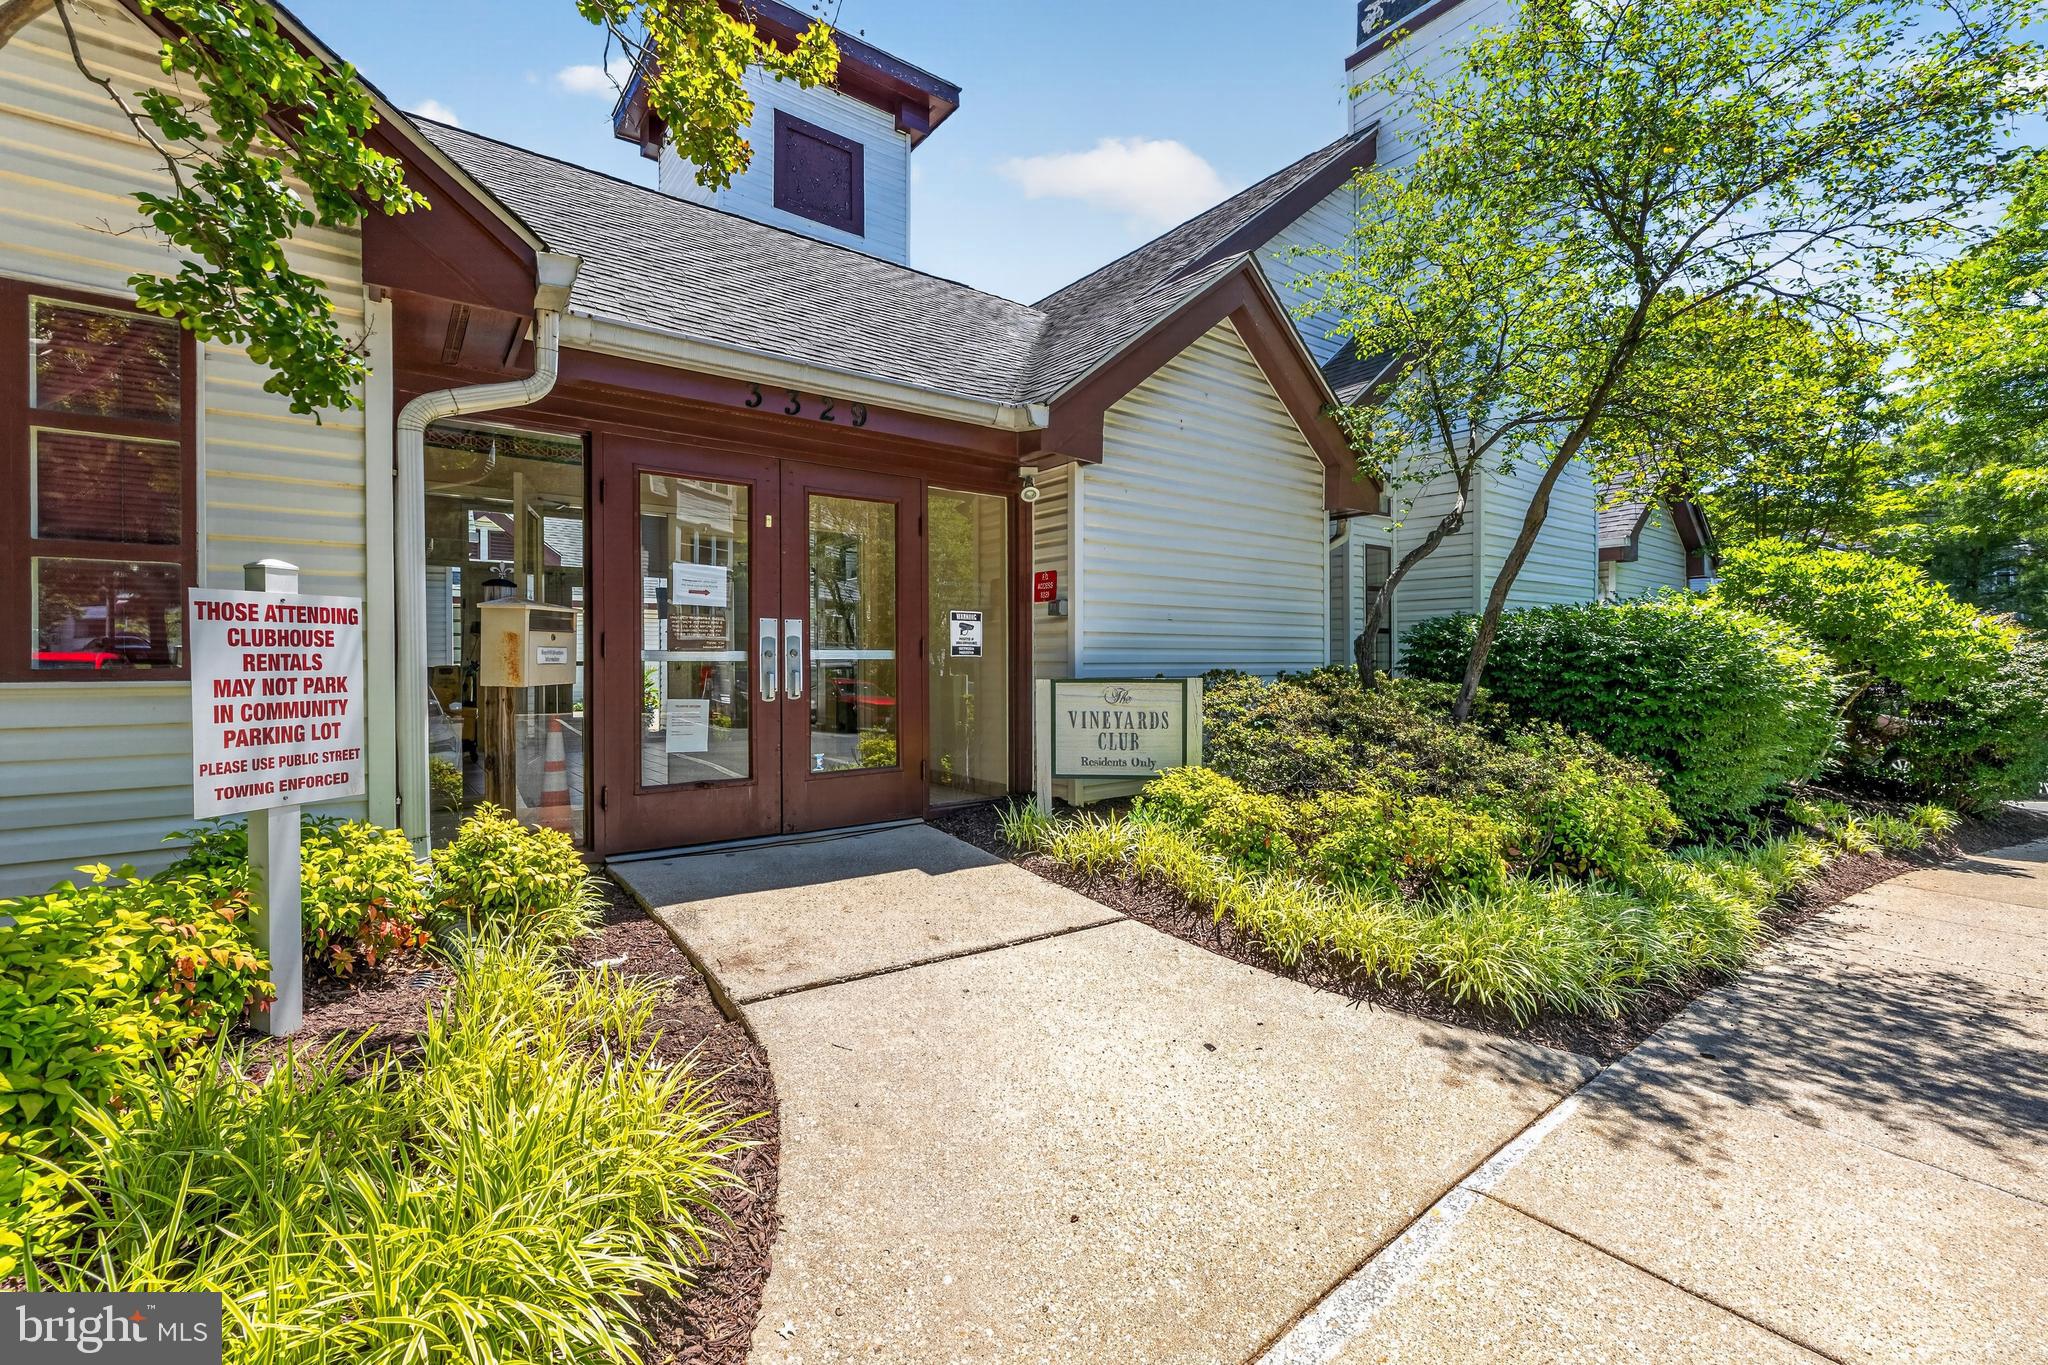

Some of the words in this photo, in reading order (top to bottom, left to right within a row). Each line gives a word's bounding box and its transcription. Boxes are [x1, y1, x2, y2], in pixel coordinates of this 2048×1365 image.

[745, 383, 867, 427] 3329
[193, 600, 259, 622] THOSE
[264, 604, 359, 625] ATTENDING
[227, 628, 335, 648] CLUBHOUSE
[243, 653, 323, 672] RENTALS
[213, 678, 257, 698] MAY
[262, 677, 298, 696] NOT
[303, 676, 348, 694] PARK
[1103, 686, 1132, 704] The
[213, 704, 234, 724] IN
[240, 699, 349, 722] COMMUNITY
[1068, 710, 1169, 729] VINEYARDS
[223, 724, 305, 749] PARKING
[311, 722, 342, 741] LOT
[1098, 732, 1140, 751] CLUB
[199, 759, 248, 777] PLEASE
[252, 757, 275, 771] USE
[278, 752, 319, 768] PUBLIC
[322, 748, 361, 763] STREET
[1080, 756, 1127, 767] Residents
[1131, 757, 1157, 770] Only
[214, 781, 275, 801] TOWING
[279, 772, 349, 792] ENFORCED
